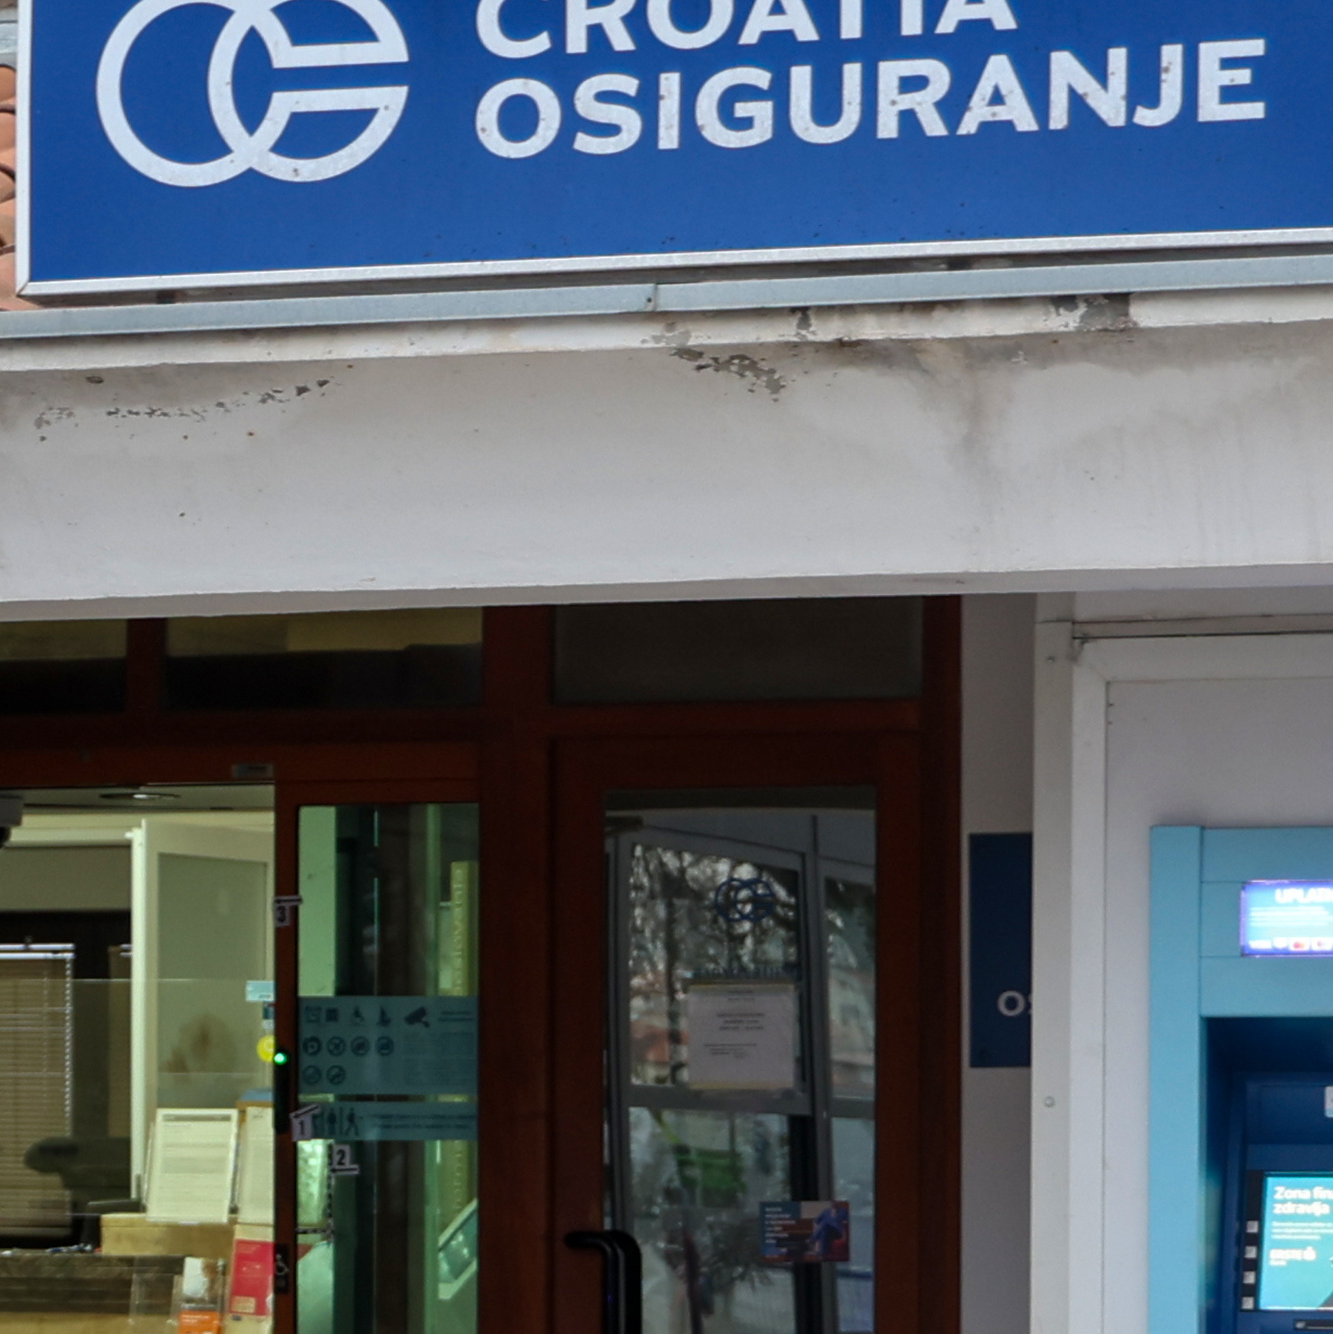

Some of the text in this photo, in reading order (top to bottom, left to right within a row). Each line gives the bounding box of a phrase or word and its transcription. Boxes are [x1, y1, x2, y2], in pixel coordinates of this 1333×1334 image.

[475, 38, 1265, 159] OSIGURANJE
[997, 990, 1032, 1017] O
[336, 1149, 346, 1166] 2
